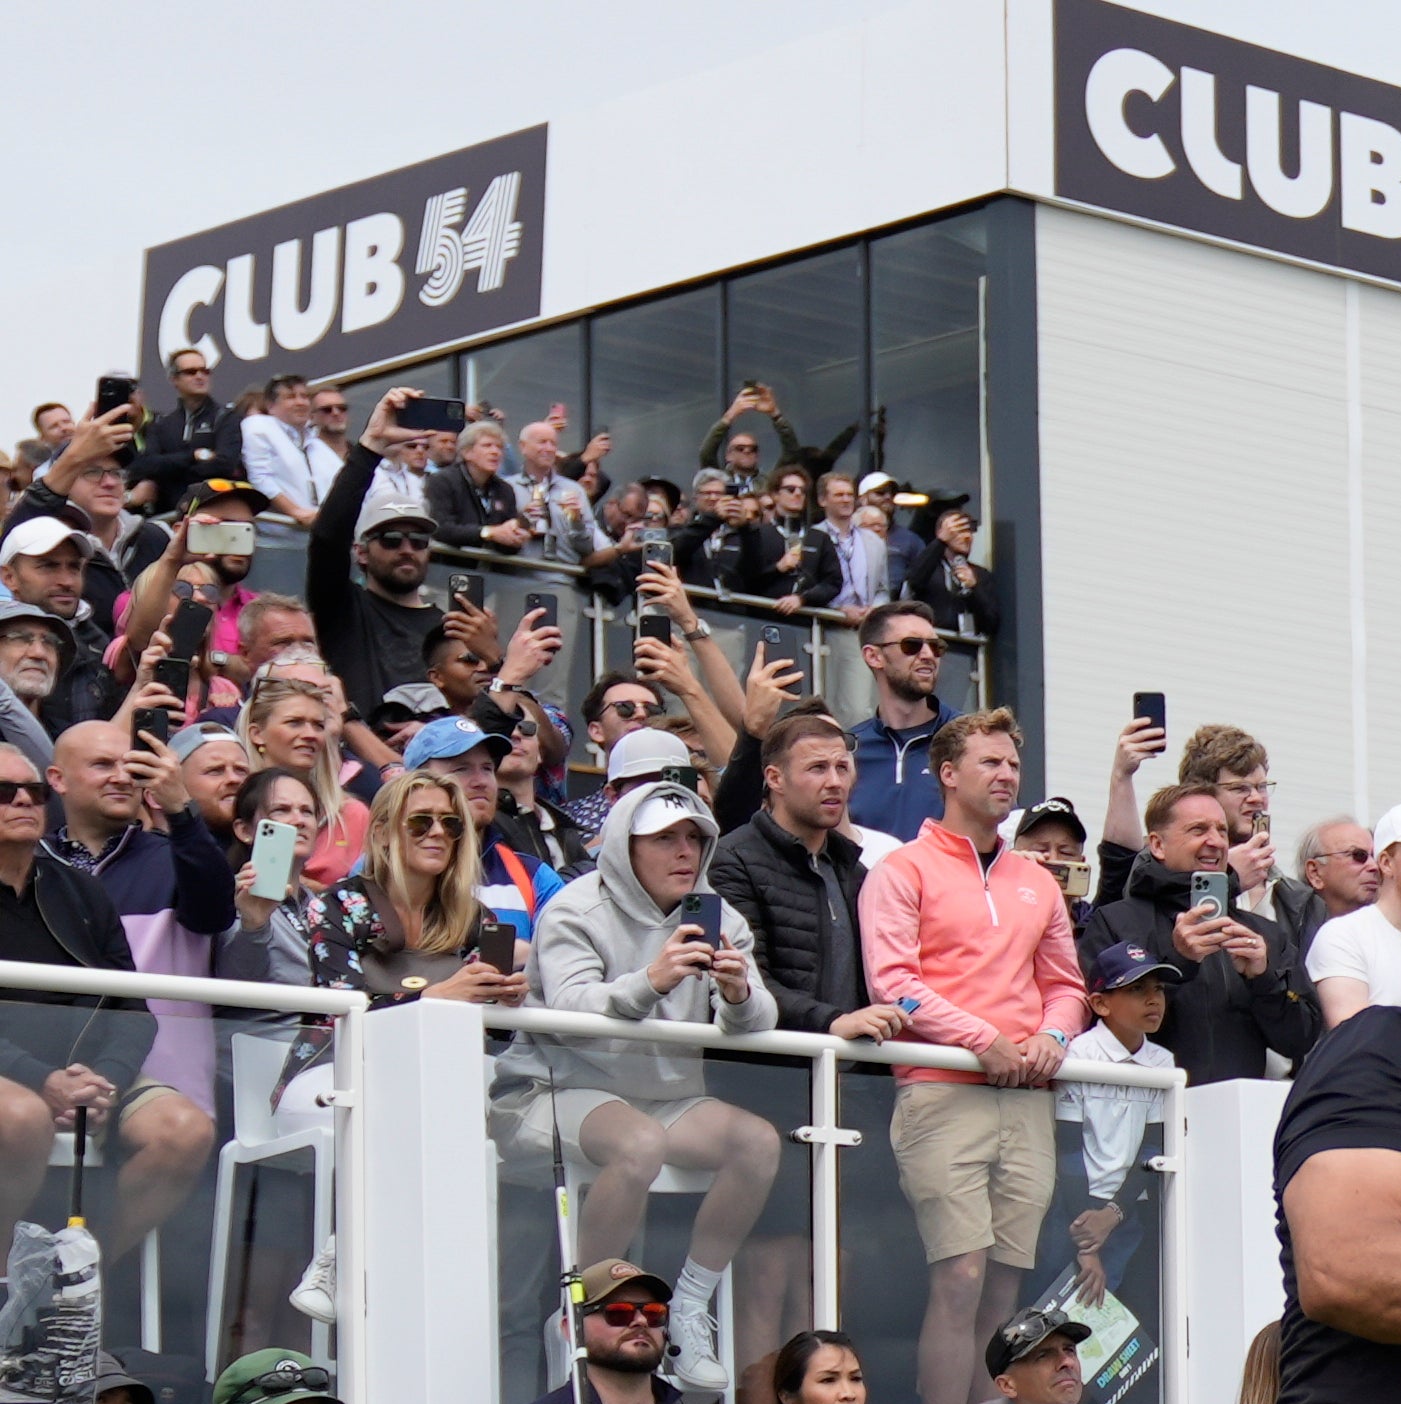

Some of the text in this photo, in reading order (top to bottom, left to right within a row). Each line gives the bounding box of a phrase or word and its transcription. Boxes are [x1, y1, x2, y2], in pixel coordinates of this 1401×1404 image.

[158, 170, 522, 371] CLUB 54
[1096, 1337, 1141, 1389] DRAW SHEET
